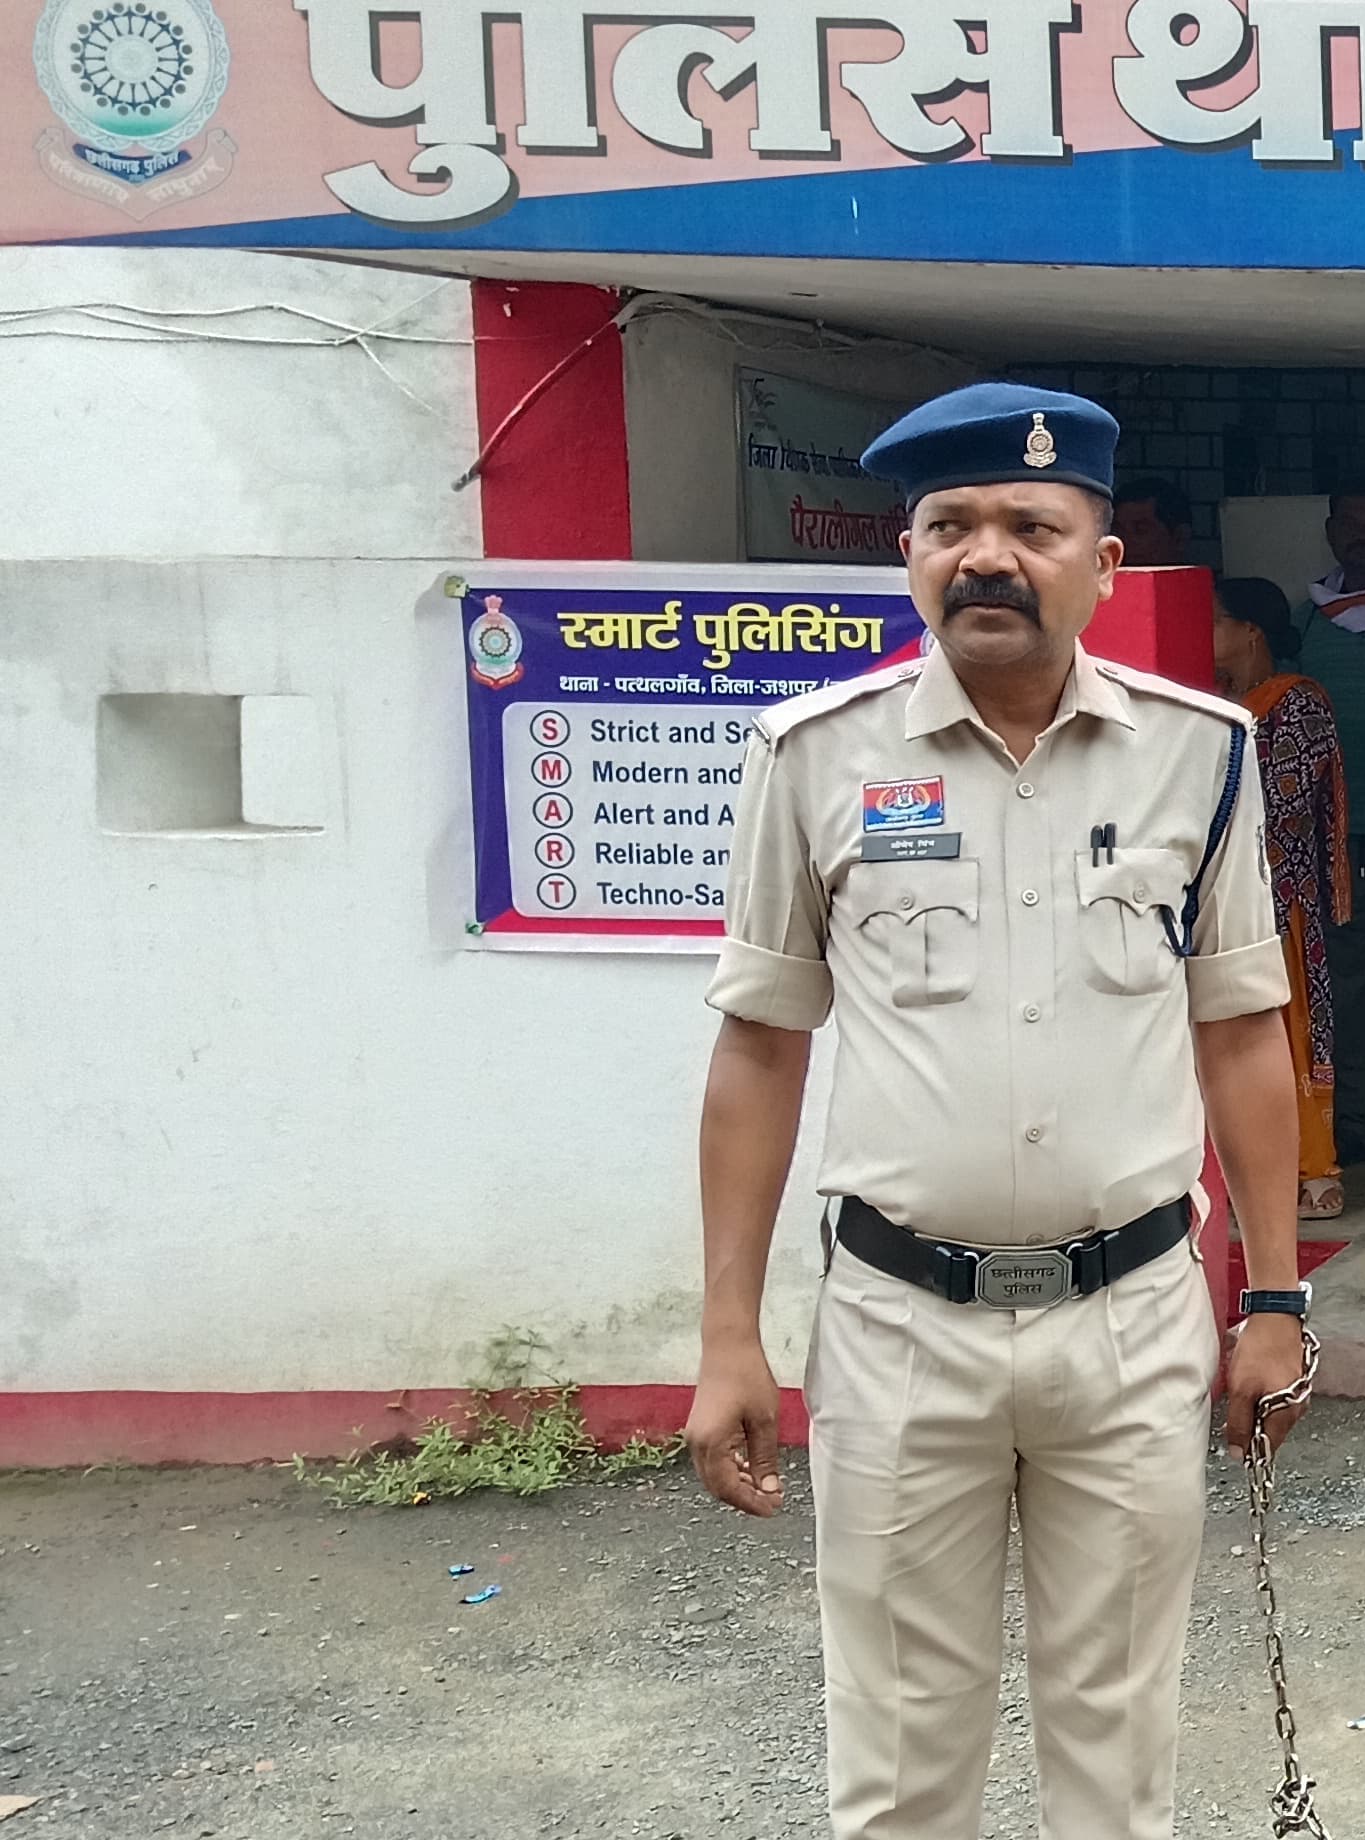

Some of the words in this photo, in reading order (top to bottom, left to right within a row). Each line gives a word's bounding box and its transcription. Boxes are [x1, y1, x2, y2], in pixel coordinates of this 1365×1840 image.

[557, 601, 683, 650] स्मार्ट
[694, 602, 883, 670] पुलिसिंग
[559, 675, 599, 693] थाना
[542, 718, 559, 740] S
[591, 719, 660, 743] Strict
[668, 721, 715, 744] and
[541, 759, 562, 780] M
[592, 760, 689, 783] Modern
[697, 763, 743, 785] and
[544, 800, 563, 821] A
[594, 802, 655, 825] Alert
[663, 804, 709, 826] and
[718, 804, 735, 826] A
[546, 840, 564, 861] R
[595, 842, 694, 865] Reliable
[702, 849, 730, 866] an
[548, 881, 565, 903] T
[596, 882, 725, 906] Techno-Sa
